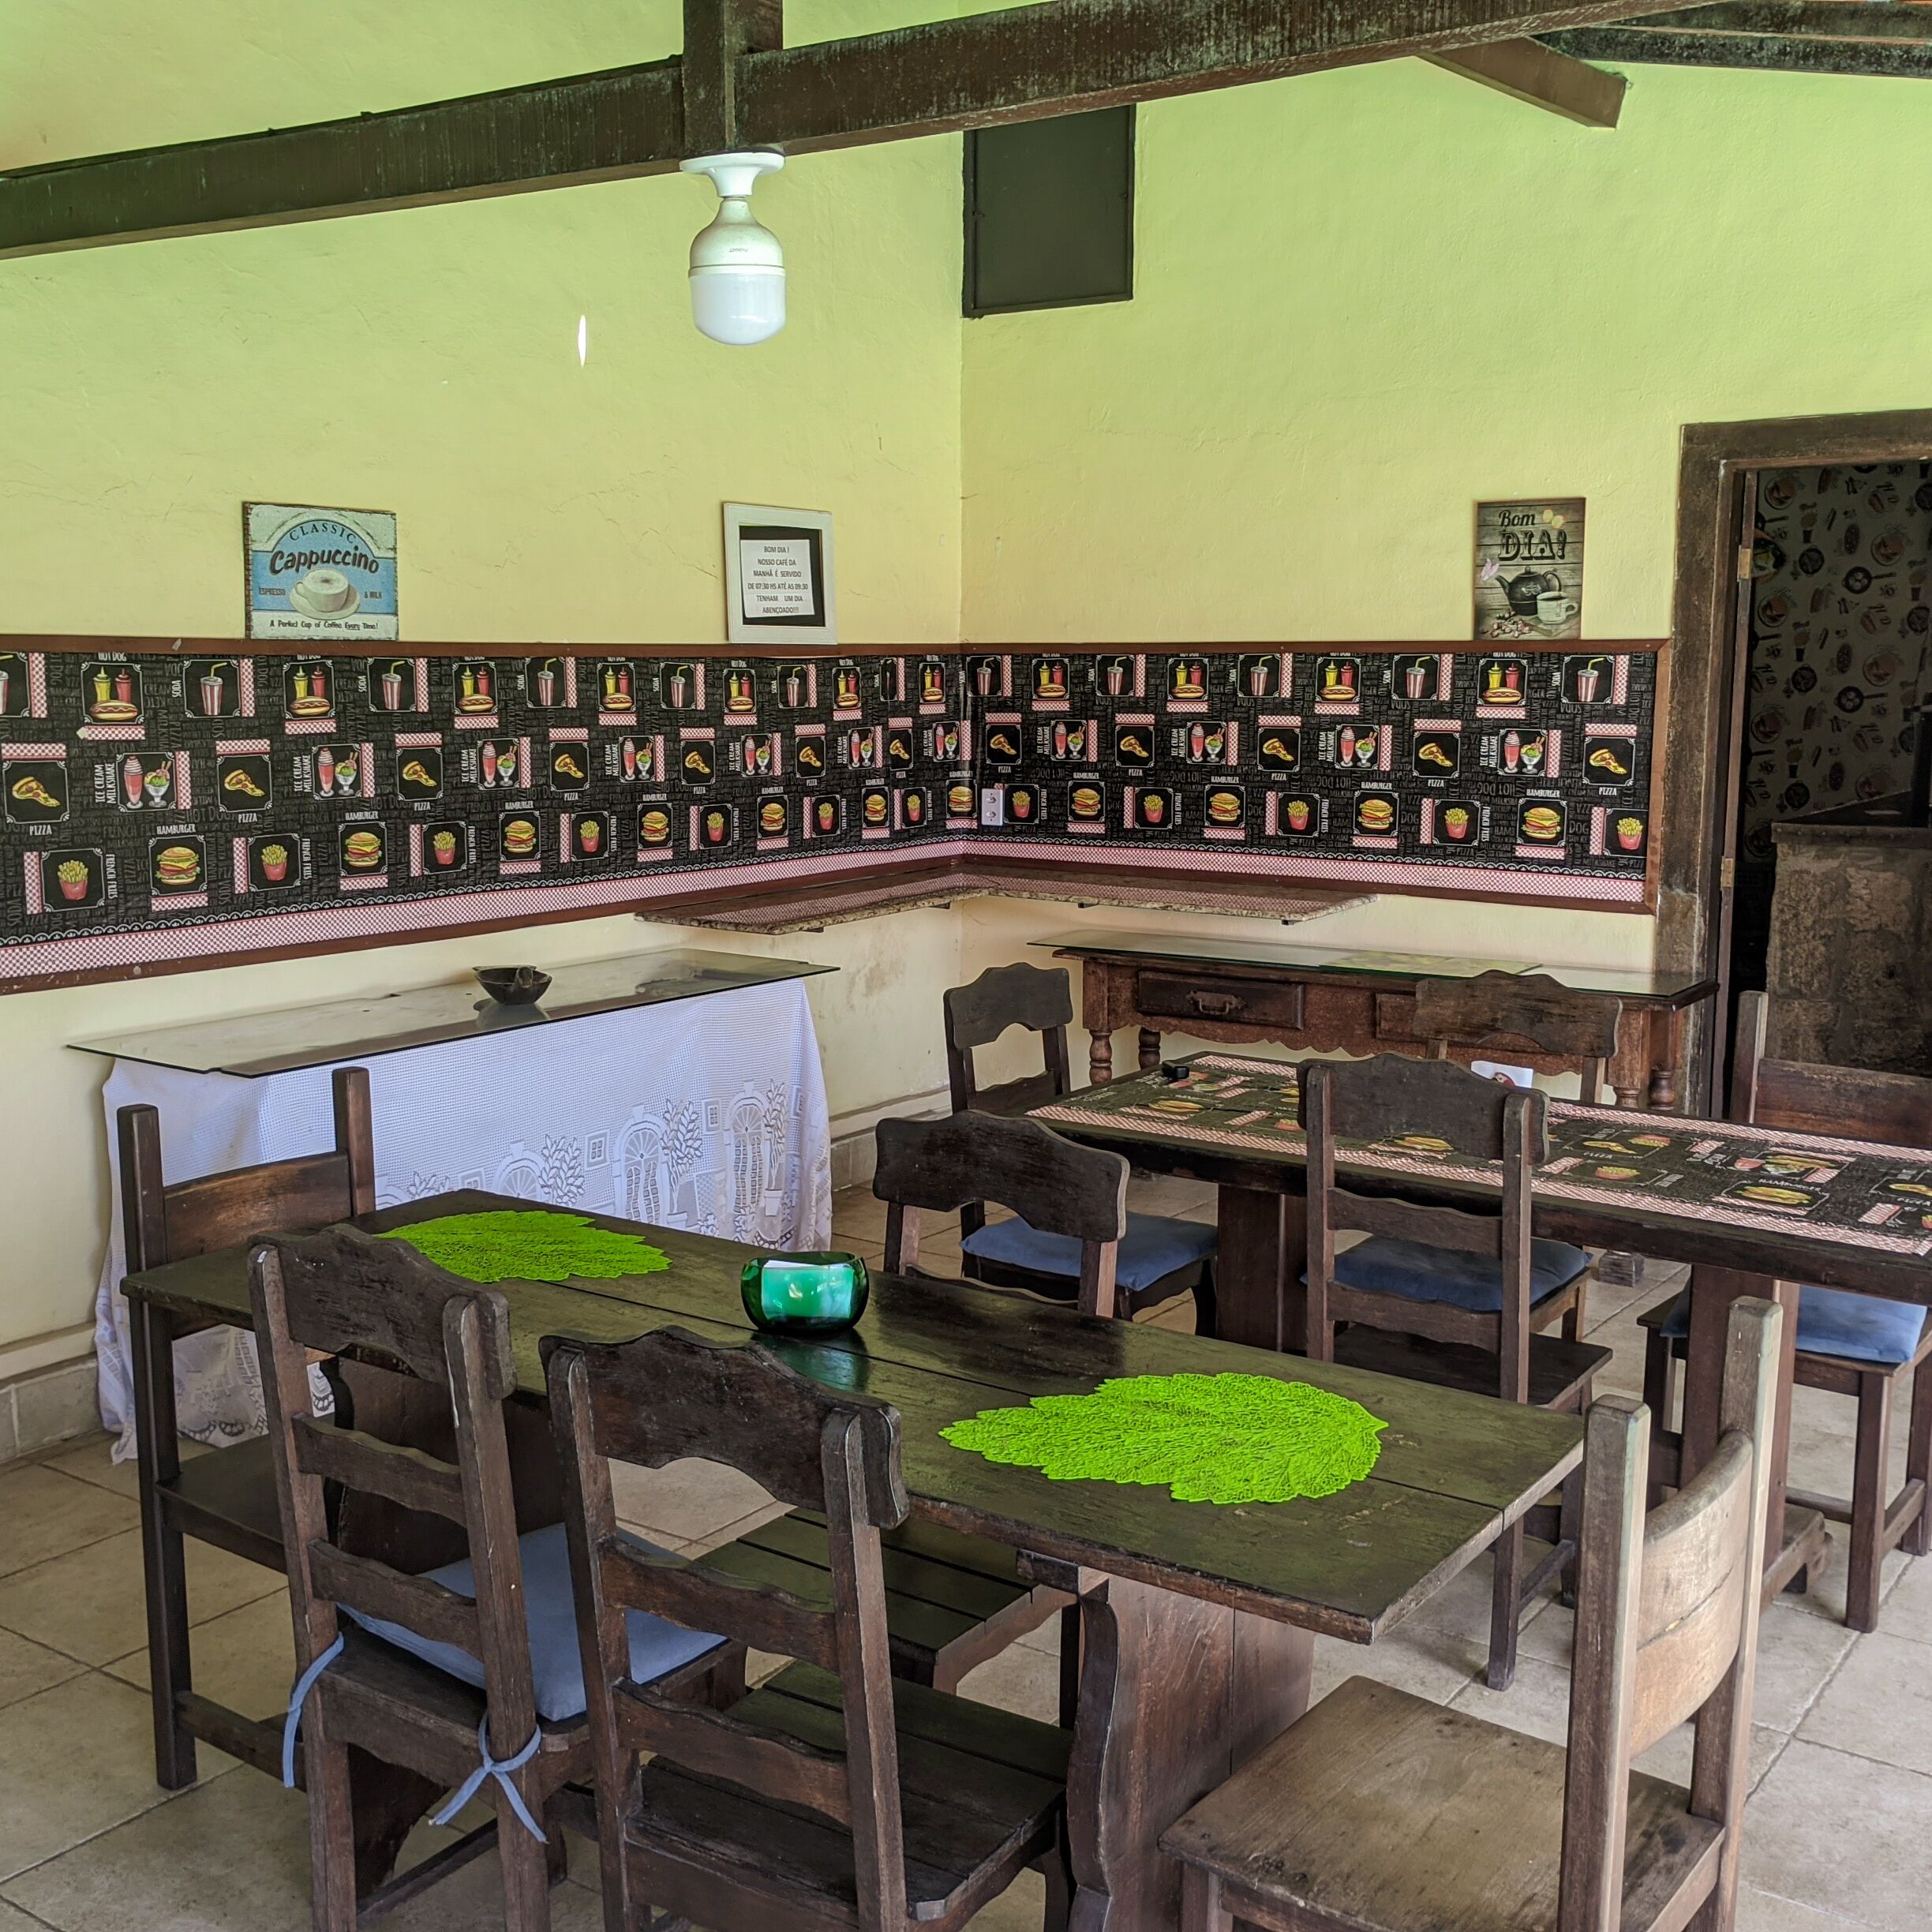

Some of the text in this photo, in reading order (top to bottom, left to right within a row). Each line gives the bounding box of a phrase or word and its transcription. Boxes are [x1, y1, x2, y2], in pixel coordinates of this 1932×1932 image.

[1499, 510, 1535, 527] Bom
[290, 522, 356, 543] CLASSIC
[1498, 529, 1567, 561] DIA!
[270, 545, 379, 575] Cappuccino
[776, 557, 788, 566] CAFÉ
[278, 620, 298, 628] Perfect
[301, 620, 311, 630] Cup
[344, 622, 360, 631] Every
[358, 676, 367, 692] SODA
[1552, 672, 1561, 686] SODA
[171, 680, 182, 698] SODA
[1327, 731, 1335, 762] MILKSHAKE
[1480, 736, 1489, 766] ICE CREAM
[1489, 736, 1498, 768] MILKSHAKE
[293, 757, 303, 792] ICE CREAM
[303, 754, 312, 792] MILKSHAKE
[95, 764, 106, 803] ICE CREAM
[105, 762, 117, 804] MILKSHAKE
[1361, 781, 1392, 790] HAMBURGER
[1428, 779, 1444, 788] PIZZA
[1599, 787, 1617, 796] PIZZA
[564, 792, 578, 801] PIZZA
[1526, 789, 1559, 798] HAMBURGER
[414, 802, 430, 811] PIZZA
[238, 813, 257, 823] PIZZA
[345, 811, 379, 821] HAMBURGER
[1482, 806, 1491, 826] FRENCH
[29, 825, 52, 836] PIZZA
[157, 824, 196, 835] HAMBURGER
[301, 838, 312, 879] FRENCH FRIES
[106, 854, 118, 899] FRENCH FRIES
